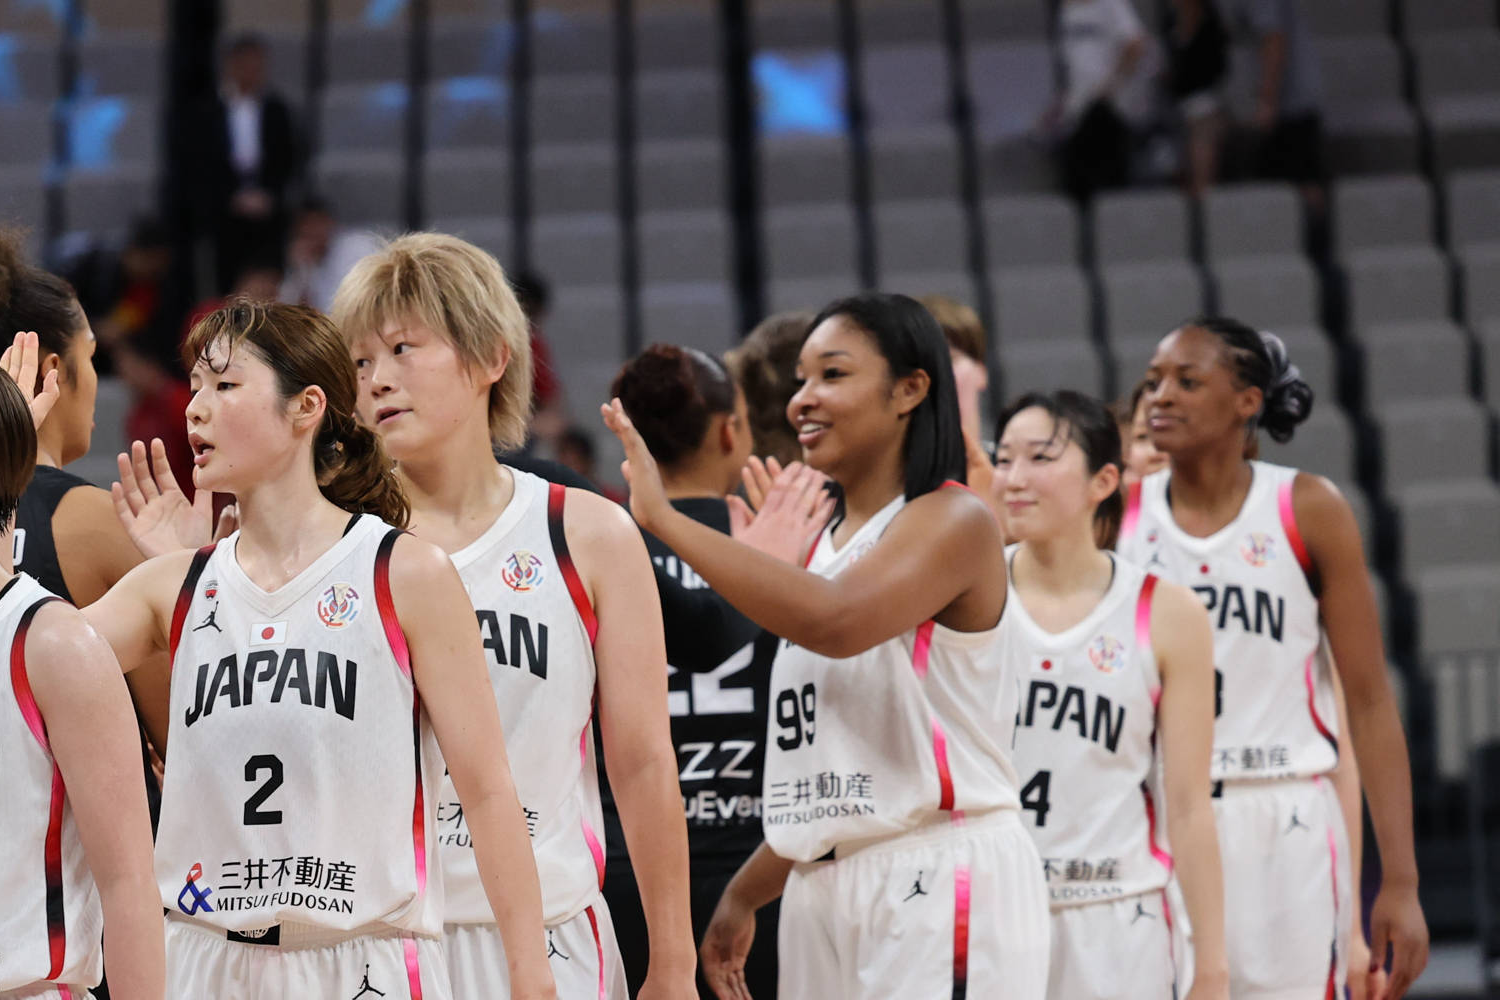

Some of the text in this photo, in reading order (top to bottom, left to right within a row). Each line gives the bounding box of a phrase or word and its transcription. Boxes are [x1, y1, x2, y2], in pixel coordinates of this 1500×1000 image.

[1192, 585, 1284, 642] PAN
[185, 648, 357, 728] JAPAN
[777, 683, 816, 751] 99
[1016, 680, 1125, 753] PAN
[679, 741, 756, 781] ZZ
[1219, 746, 1291, 771] 不動産
[243, 754, 284, 826] 2
[219, 856, 357, 893] 三井不動産
[1041, 857, 1118, 882] 不動産
[216, 891, 353, 915] MITSUI FUDOSAN
